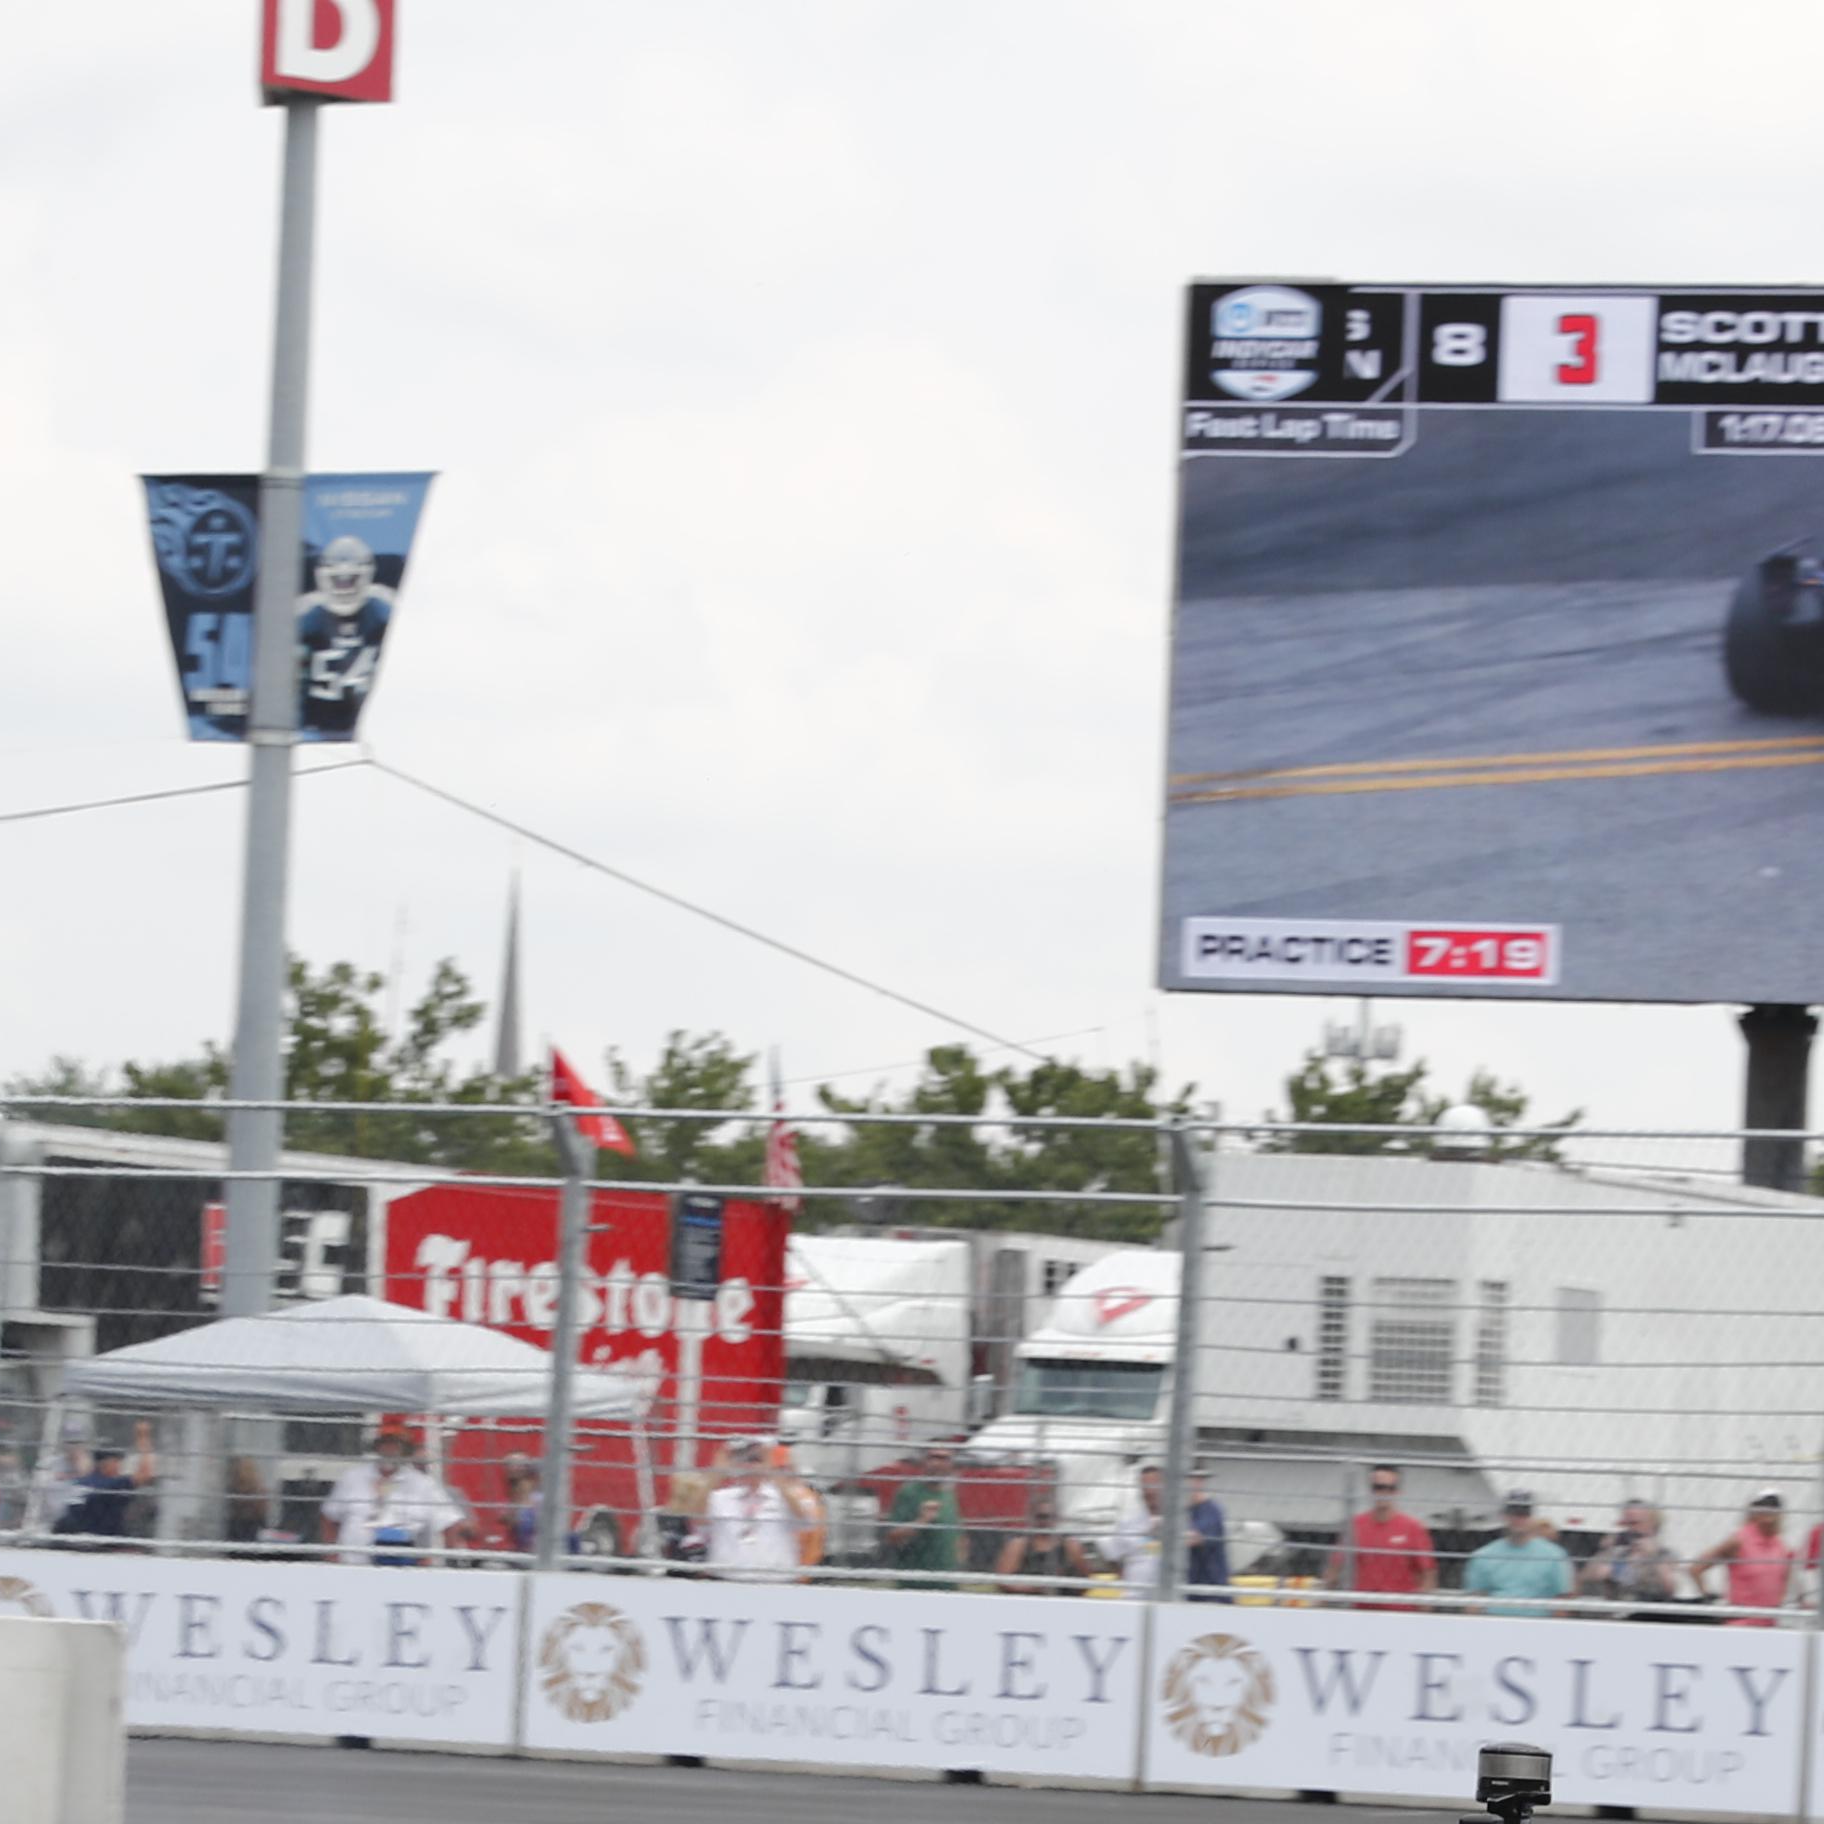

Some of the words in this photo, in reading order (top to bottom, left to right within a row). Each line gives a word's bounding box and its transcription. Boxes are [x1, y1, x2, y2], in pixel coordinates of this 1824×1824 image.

[1432, 323, 1486, 366] 8
[1558, 315, 1597, 385] 3
[1187, 412, 1256, 440] Fast
[1262, 413, 1319, 443] Lap
[1323, 413, 1401, 441] Time
[307, 648, 381, 701] 54
[1198, 934, 1395, 965] PRACTICE
[1412, 937, 1541, 970] 7:19
[69, 1589, 508, 1671] WESLEY
[662, 1616, 1131, 1702] WESLEY
[129, 1674, 313, 1711] NANCIAL
[323, 1679, 470, 1718] GROUP
[1295, 1646, 1794, 1737] WESLEY
[694, 1698, 918, 1743] FINANCIAL
[930, 1708, 1088, 1751] GROUP
[1330, 1731, 1566, 1778] FINANL
[1579, 1743, 1746, 1785] GROUP
